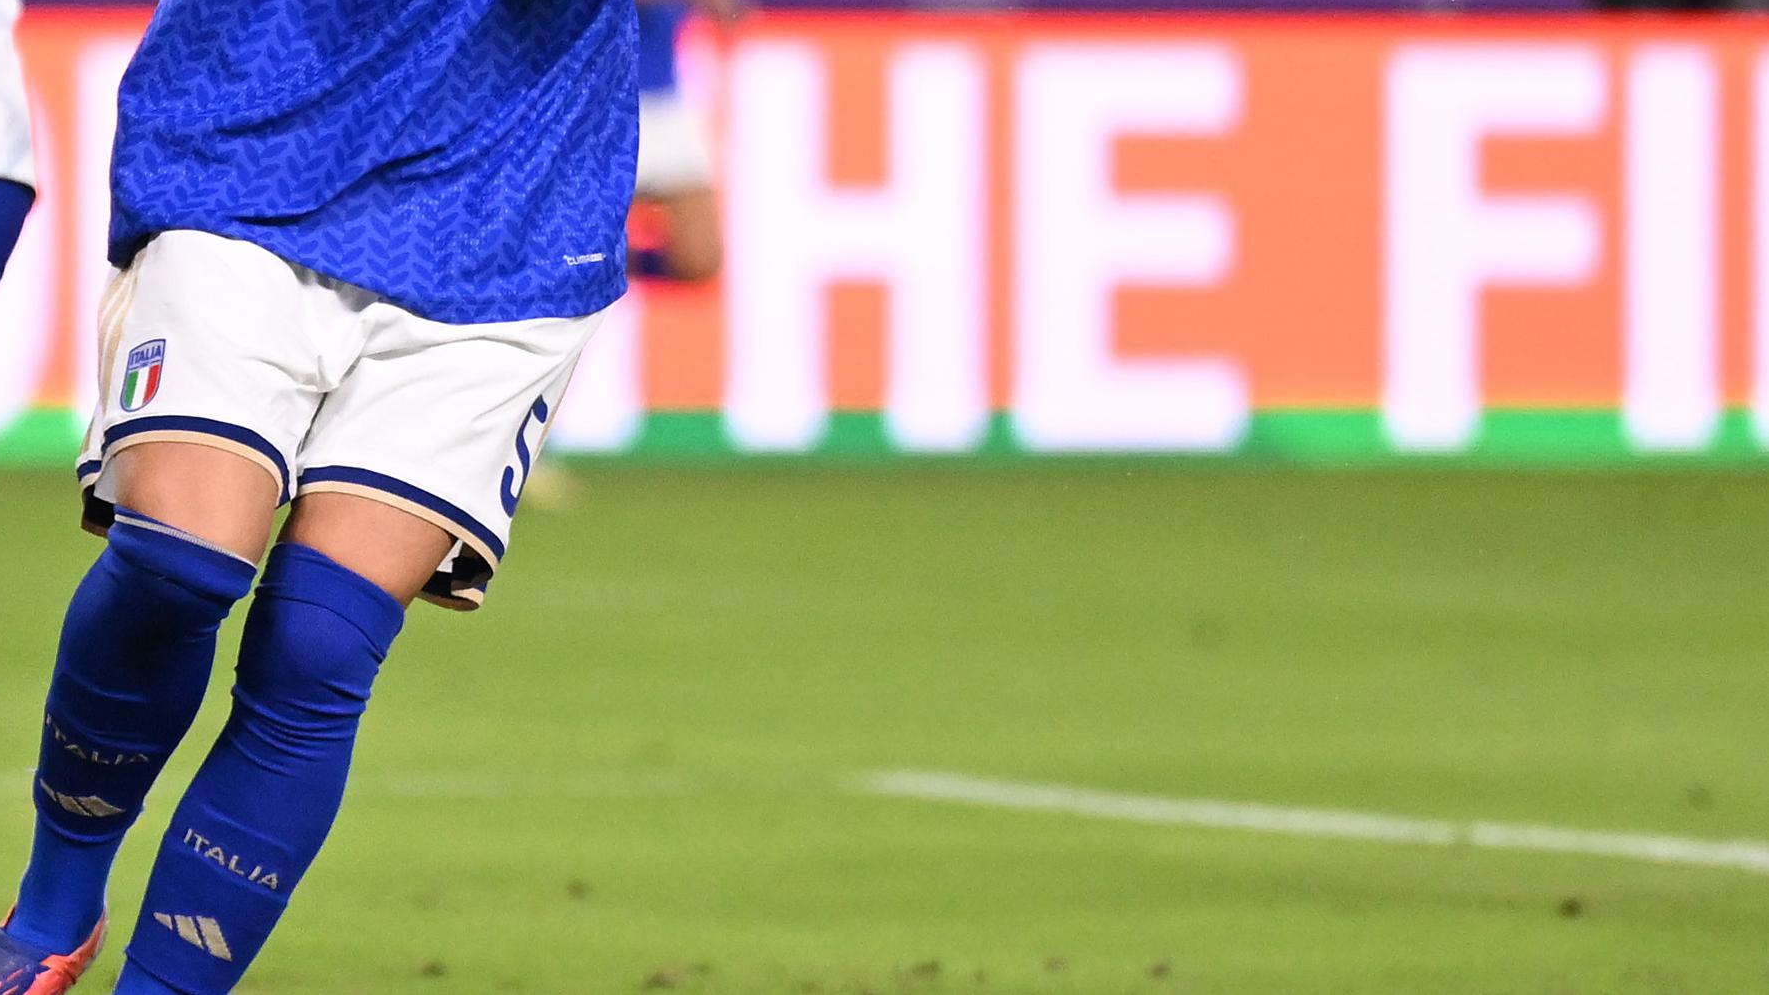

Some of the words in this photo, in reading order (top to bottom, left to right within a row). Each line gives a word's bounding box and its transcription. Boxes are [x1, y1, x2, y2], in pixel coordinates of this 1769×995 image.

[1381, 41, 1769, 452] FI
[130, 344, 162, 367] ITALIA
[183, 828, 279, 890] ITALIA
